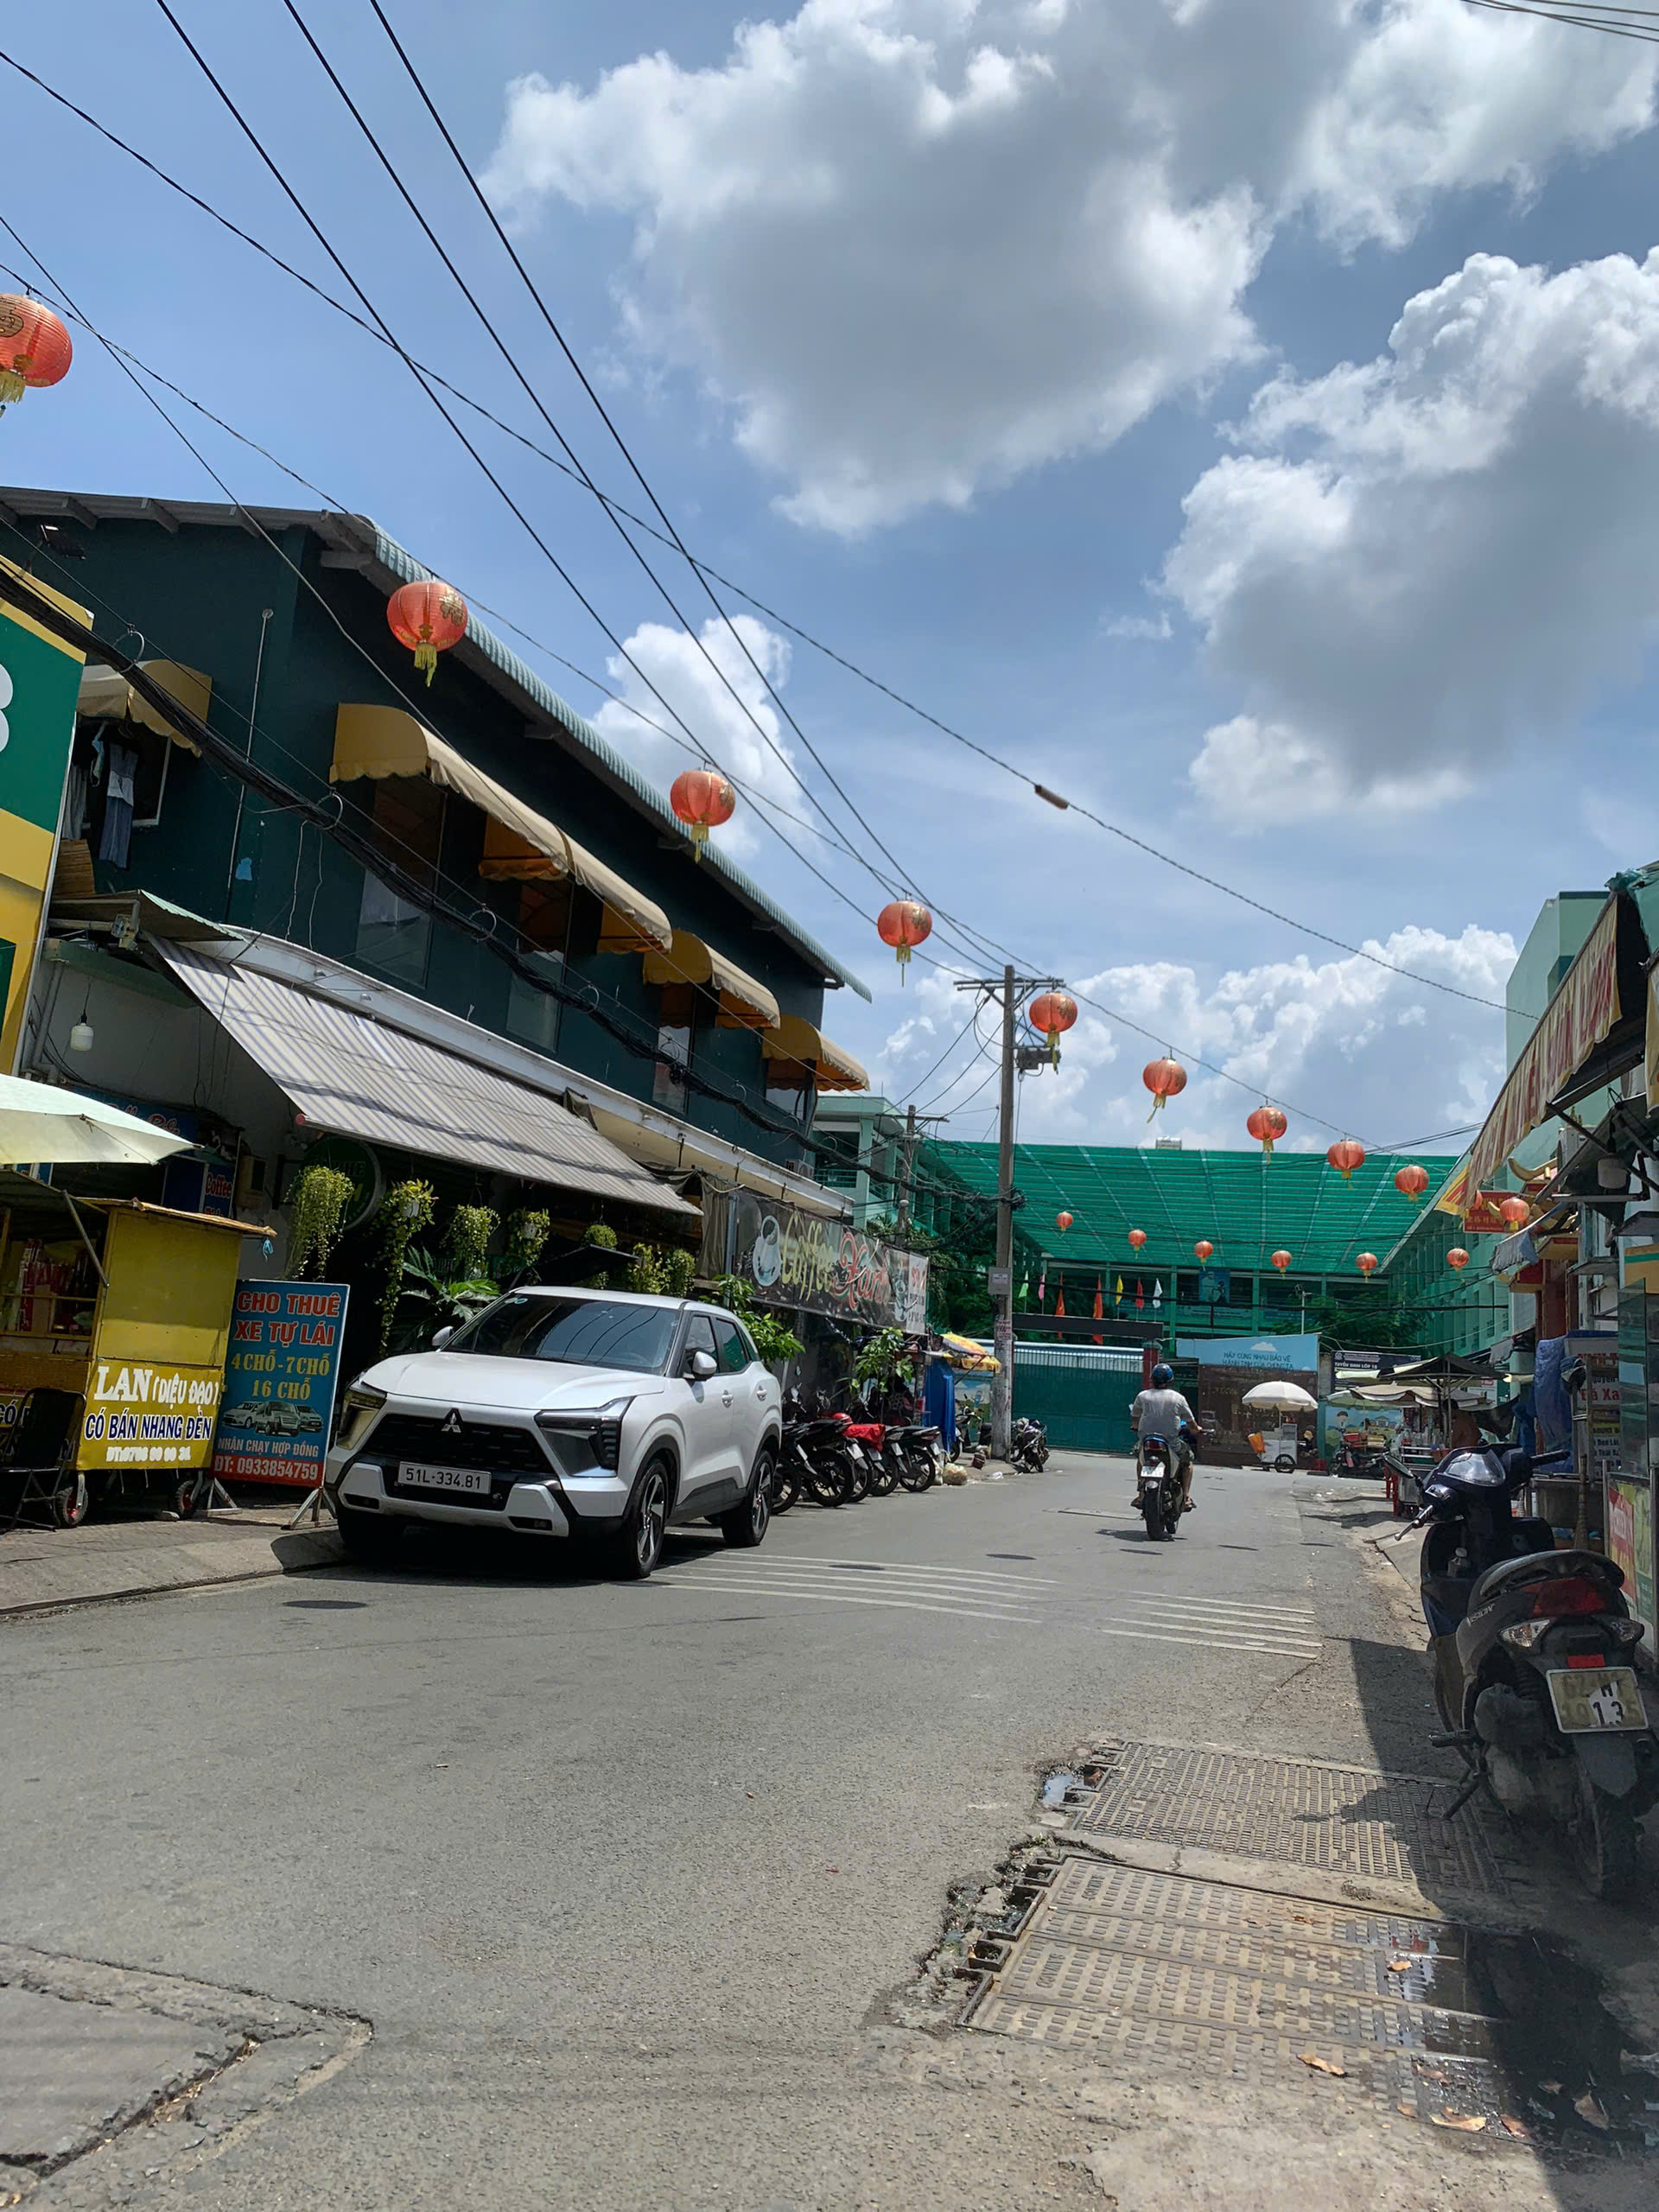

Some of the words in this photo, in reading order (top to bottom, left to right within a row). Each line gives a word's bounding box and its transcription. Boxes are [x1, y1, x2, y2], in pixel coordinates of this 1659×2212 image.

[206, 1172, 233, 1199] Coffee
[781, 1211, 835, 1301] Coffee
[237, 1292, 281, 1313] CHO
[286, 1293, 341, 1317] THUÊ
[234, 1320, 263, 1342] XE
[269, 1321, 298, 1348] TỰ
[299, 1320, 335, 1346] LÁI
[93, 1365, 153, 1402] LAN
[251, 1379, 271, 1397] 16
[277, 1376, 311, 1401] CHỖ
[85, 1407, 107, 1440] CÓ
[107, 1407, 138, 1440] BÁN
[139, 1414, 184, 1440] NHANG
[184, 1409, 213, 1440] ĐÈN
[218, 1436, 244, 1452] NHẬN
[245, 1439, 270, 1455] CHẠY
[271, 1440, 291, 1457] HỢP
[293, 1440, 319, 1458] ĐỒNG
[214, 1456, 233, 1472] ĐT:
[238, 1458, 319, 1481] 0933854759
[406, 1467, 481, 1490] 51L-334.81
